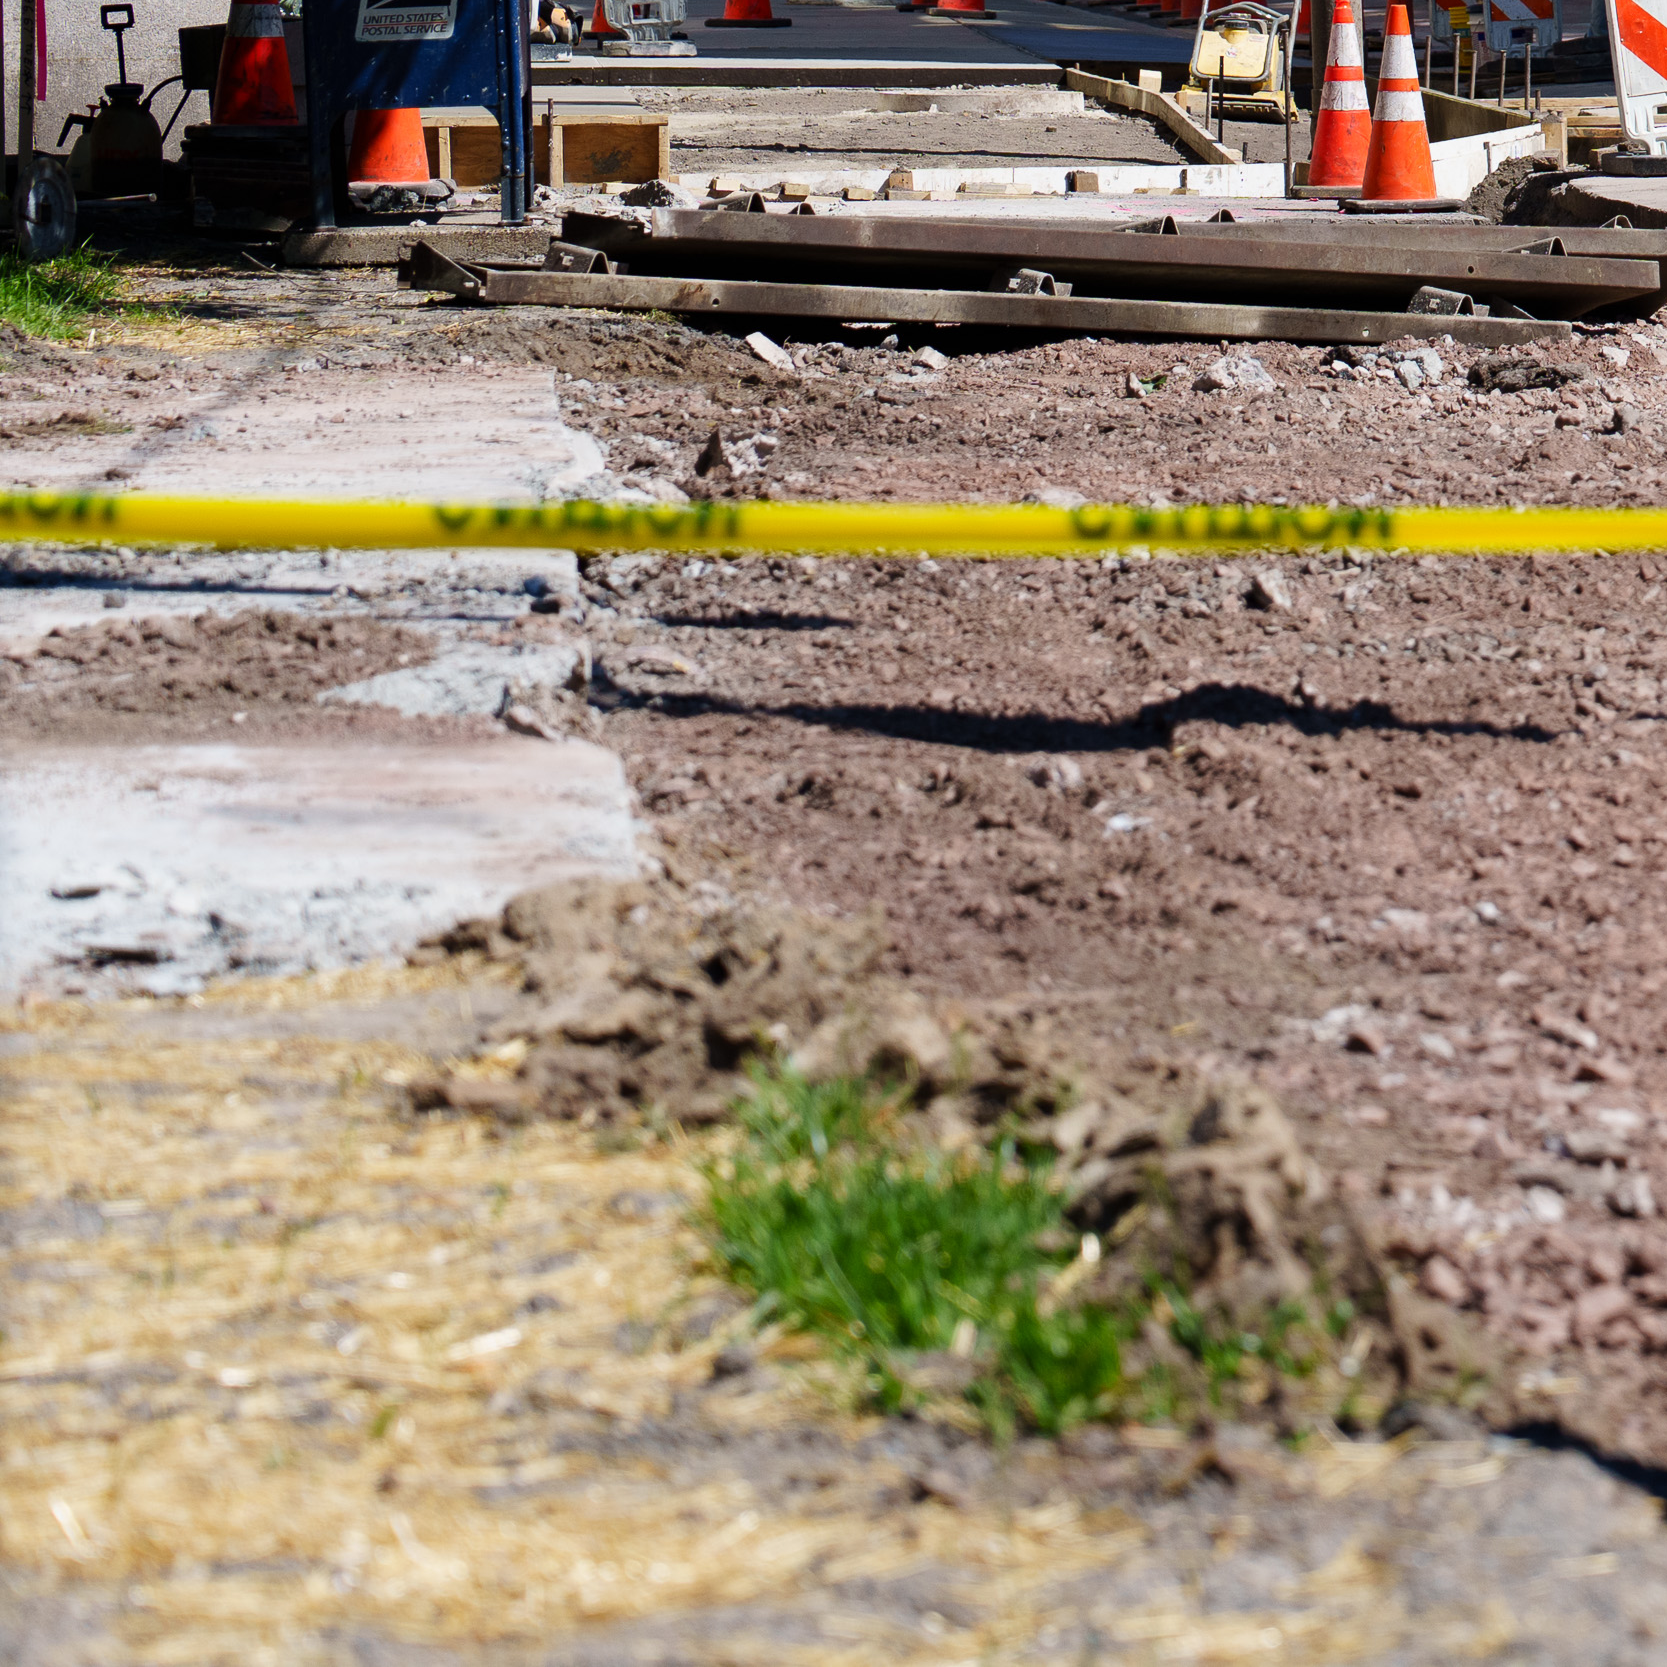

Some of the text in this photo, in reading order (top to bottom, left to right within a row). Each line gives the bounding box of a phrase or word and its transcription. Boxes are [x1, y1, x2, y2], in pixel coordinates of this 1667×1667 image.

[362, 12, 445, 25] UNITED STATES
[361, 23, 448, 37] POSTAL SERVICE
